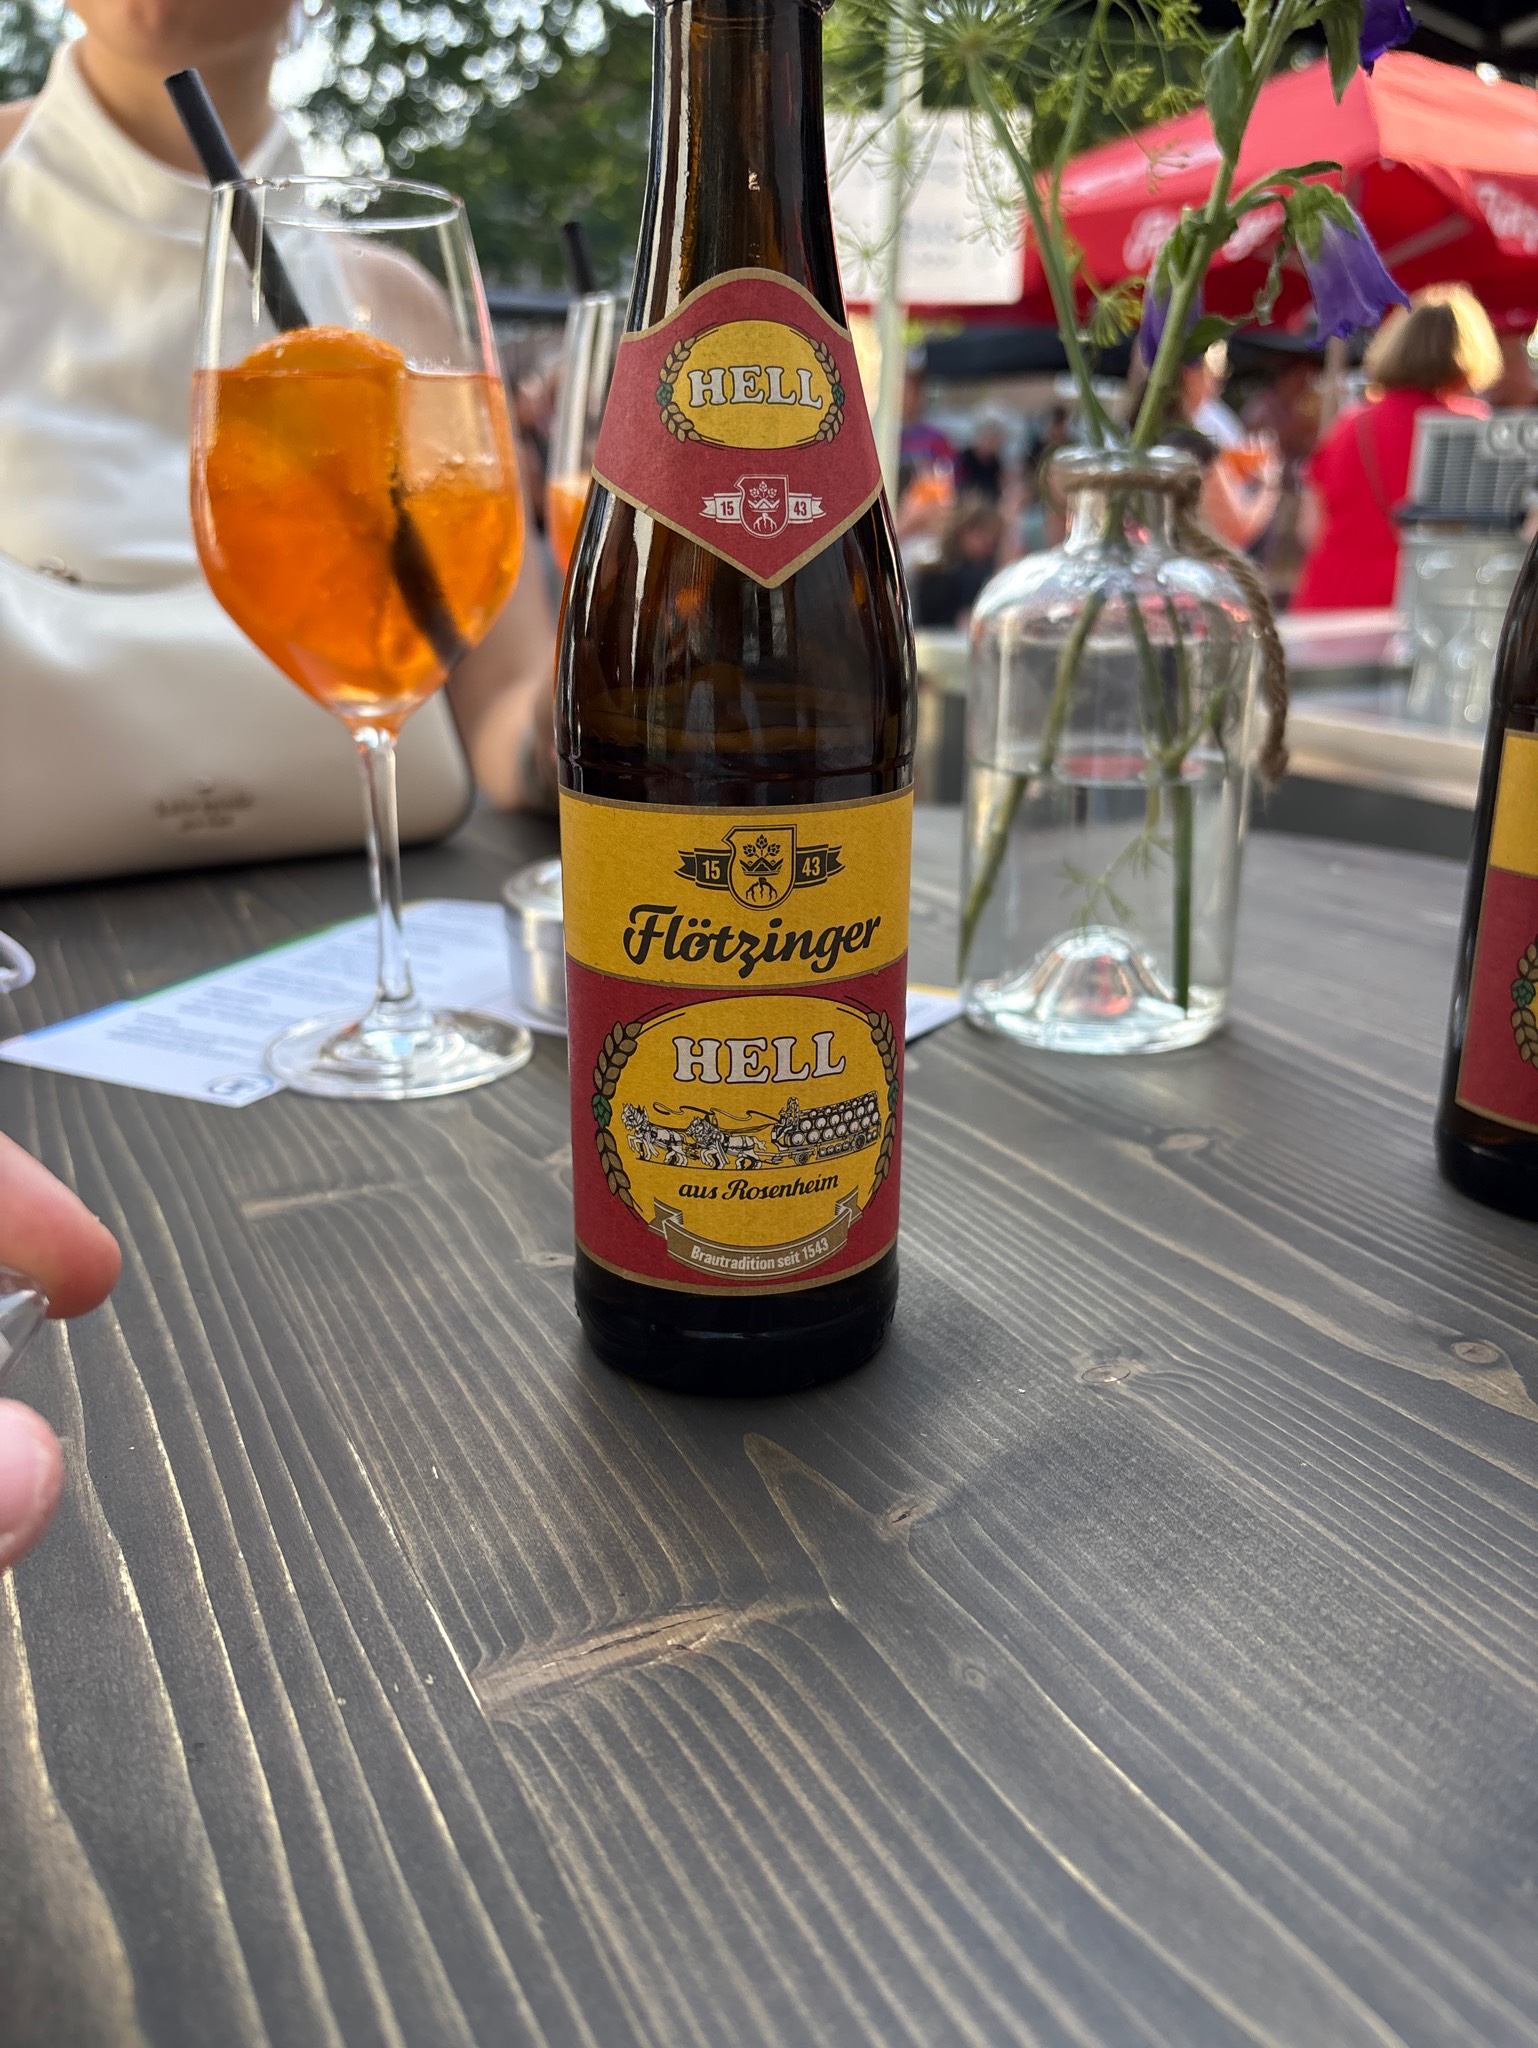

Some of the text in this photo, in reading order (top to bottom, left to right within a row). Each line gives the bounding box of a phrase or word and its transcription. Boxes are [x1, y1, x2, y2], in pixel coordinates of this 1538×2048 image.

[687, 365, 823, 409] HELL
[721, 501, 807, 516] 15 43
[703, 857, 821, 880] 15 43
[623, 904, 881, 979] Flötzinger
[672, 1030, 847, 1084] HELL
[678, 1173, 839, 1201] aus Rosenheim
[691, 1237, 829, 1270] Brautradition seit 1543
